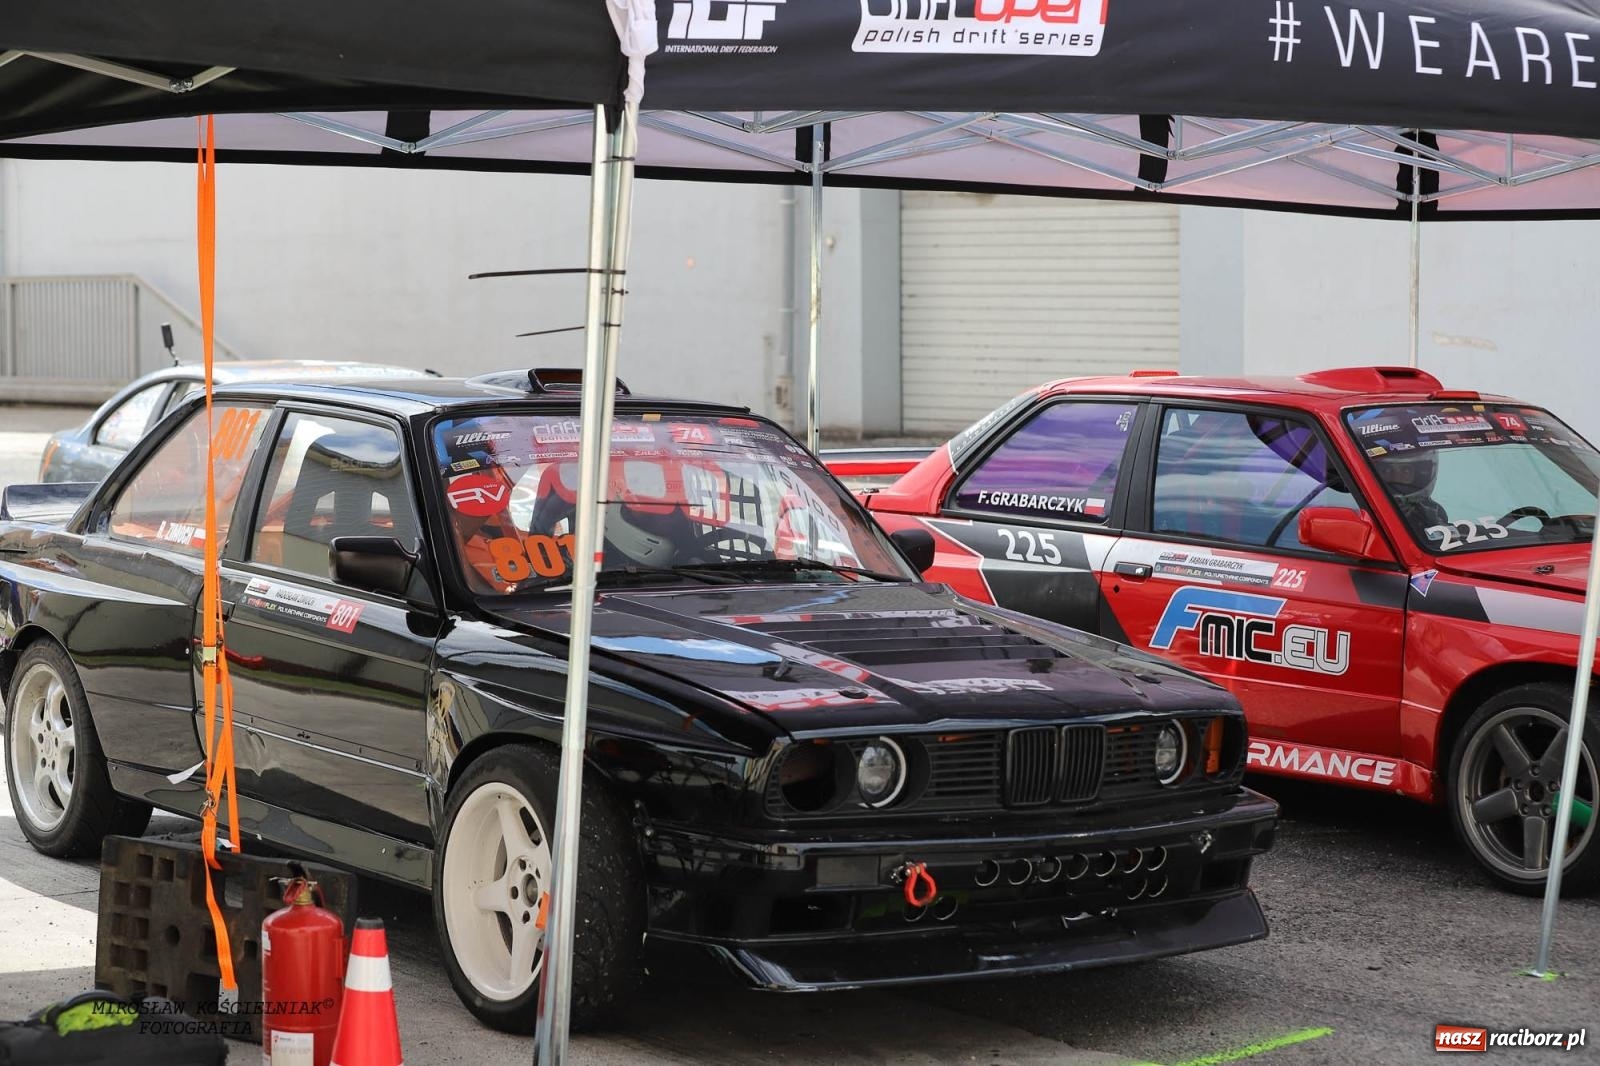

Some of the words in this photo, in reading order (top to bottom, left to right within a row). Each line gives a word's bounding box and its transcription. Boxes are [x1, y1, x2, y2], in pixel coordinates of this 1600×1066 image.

[863, 28, 941, 46] polish
[953, 29, 1006, 44] drift
[1018, 32, 1095, 47] series
[664, 45, 719, 53] INTERNATIONAL
[719, 45, 740, 53] DRIFT
[1359, 423, 1400, 435] Ultime
[1500, 416, 1522, 428] 74
[213, 407, 262, 461] 801
[677, 425, 706, 441] 74
[977, 490, 1086, 514] F.GRABARCZYK
[1427, 518, 1509, 551] 225
[997, 527, 1063, 566] 225
[1189, 556, 1209, 566] FABIAN
[1208, 559, 1245, 570] GRABARCZYK
[1273, 567, 1307, 589] 225
[331, 603, 360, 629] 801
